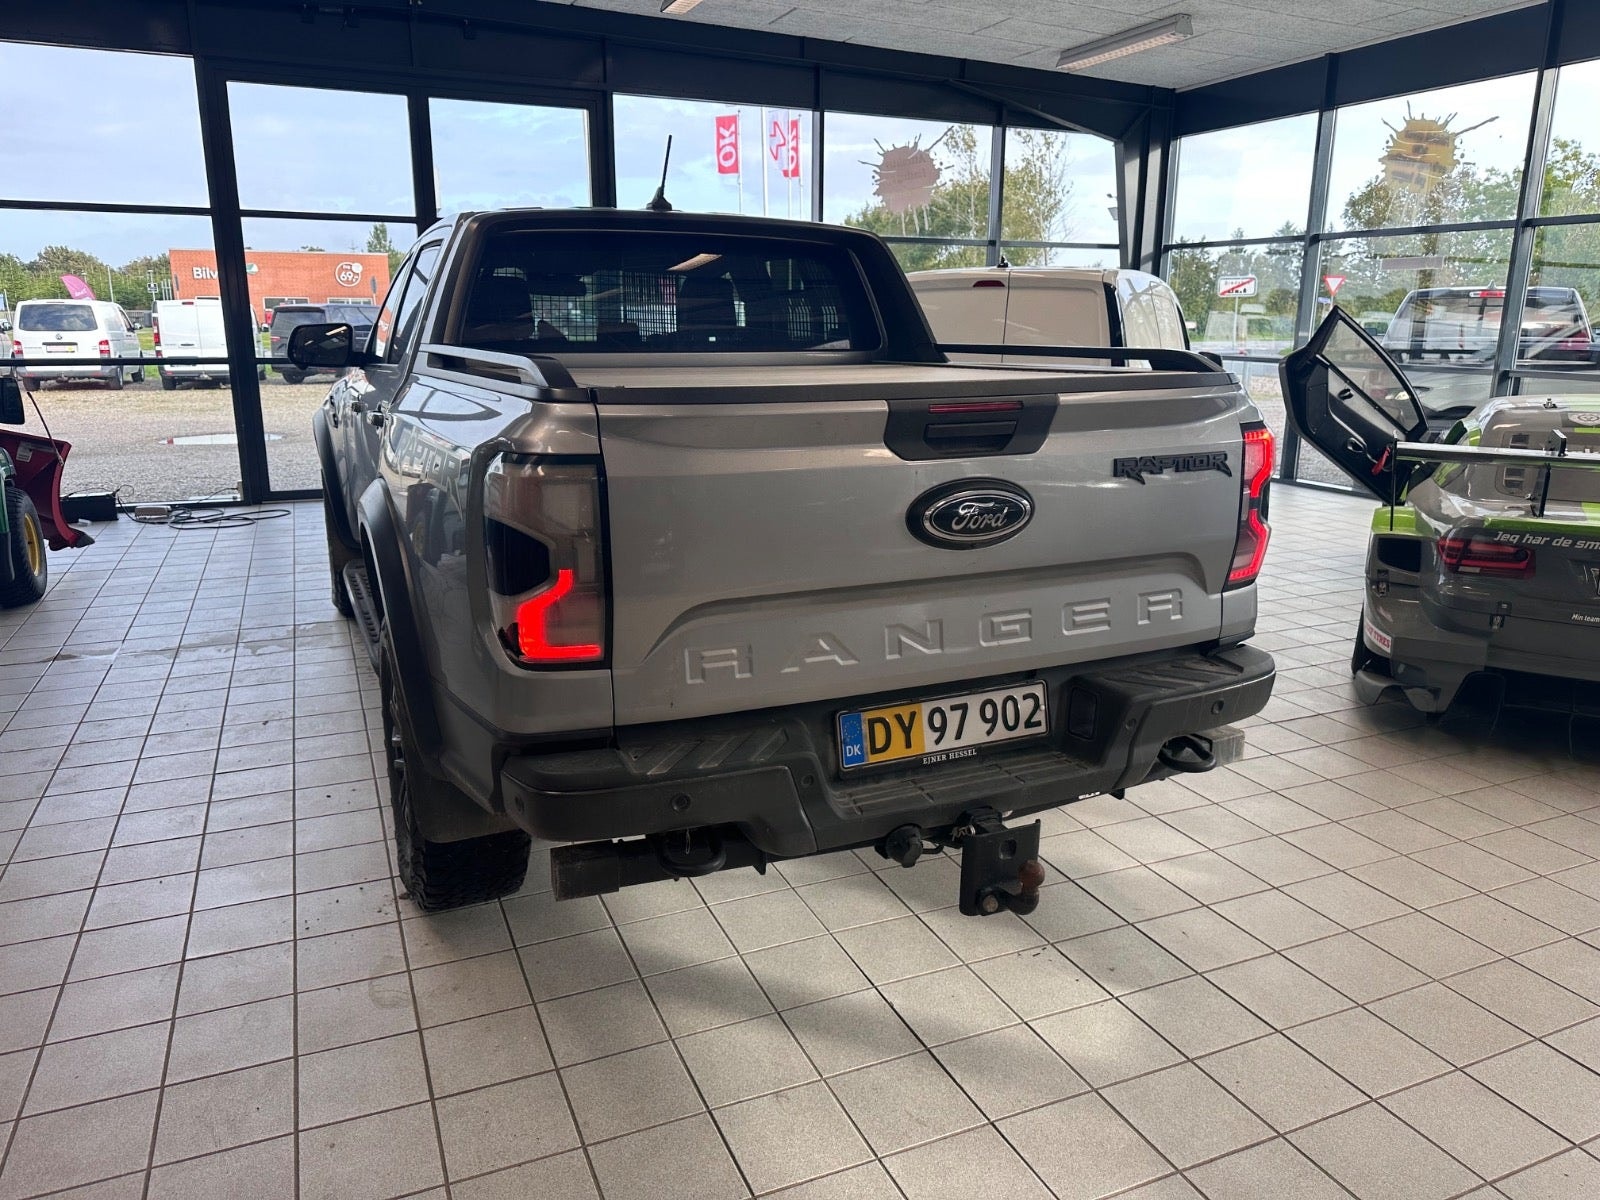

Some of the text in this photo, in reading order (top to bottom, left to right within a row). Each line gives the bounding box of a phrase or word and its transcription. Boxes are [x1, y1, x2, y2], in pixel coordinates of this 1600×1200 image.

[718, 123, 737, 168] OK
[1113, 450, 1233, 485] RAPTOR
[951, 501, 1009, 530] Ford
[1522, 533, 1551, 546] har
[1552, 537, 1573, 548] de
[1574, 540, 1600, 551] sm
[684, 587, 1184, 686] RANGER
[867, 692, 1042, 756] DY 97 902
[845, 743, 862, 757] DK
[922, 748, 978, 765] EJNER HESSEL
